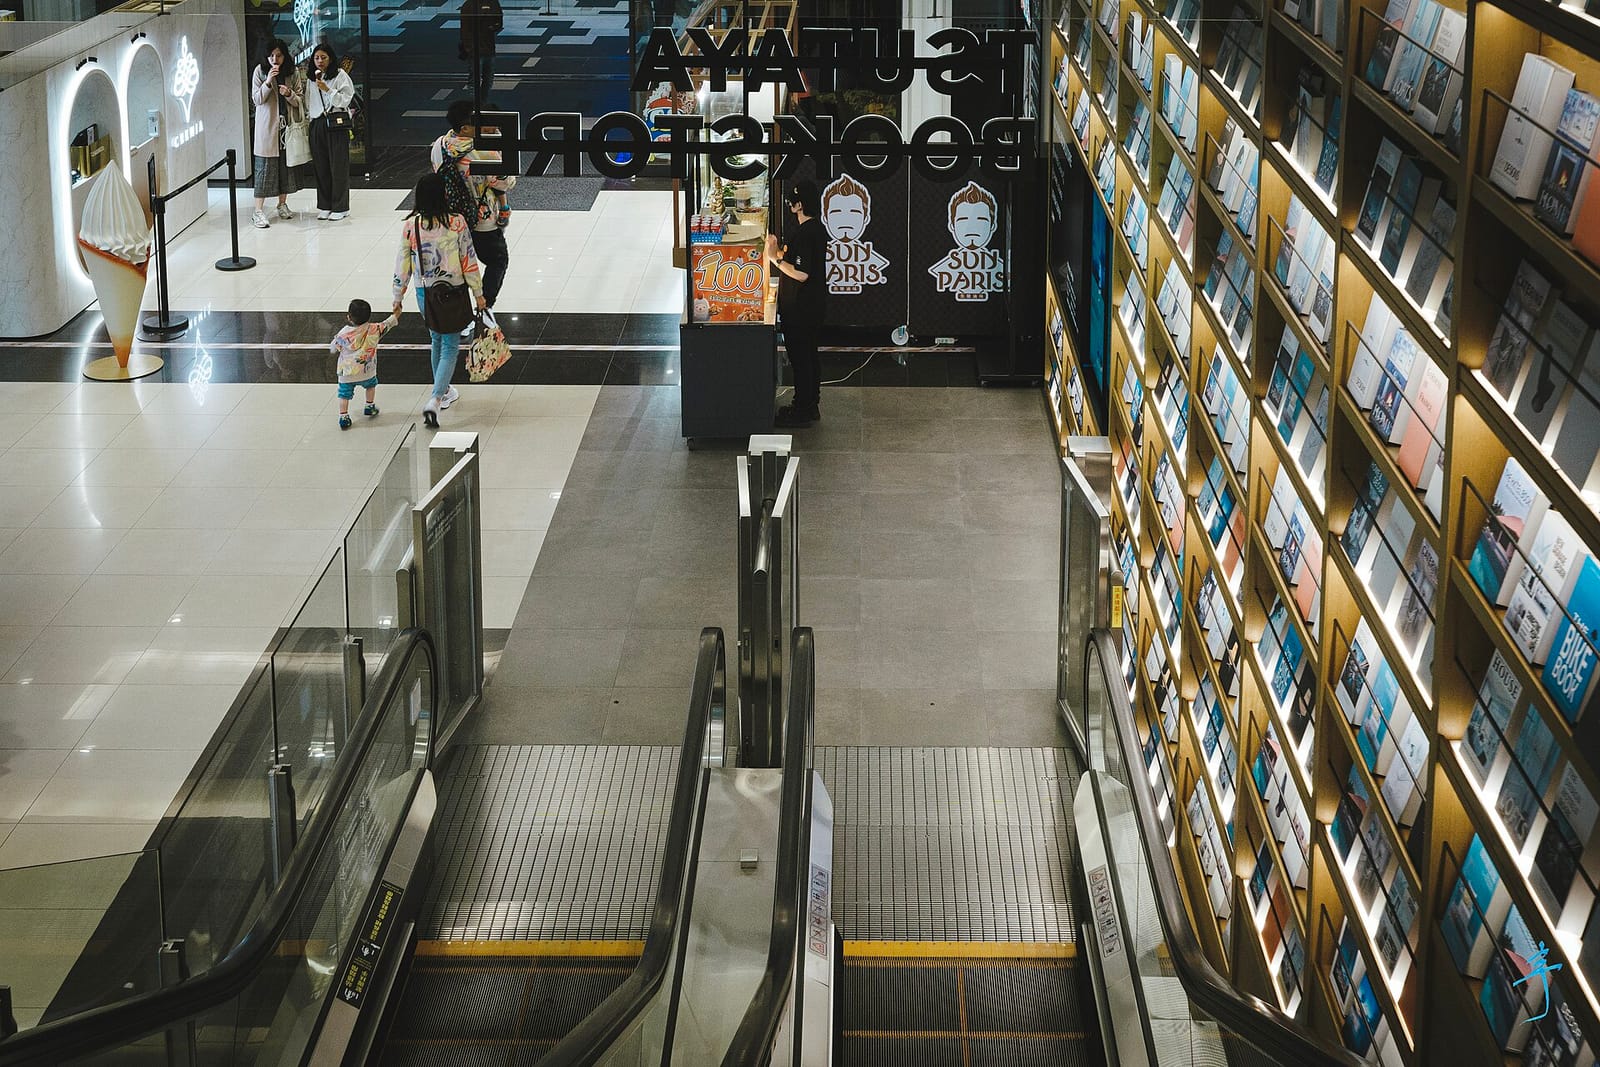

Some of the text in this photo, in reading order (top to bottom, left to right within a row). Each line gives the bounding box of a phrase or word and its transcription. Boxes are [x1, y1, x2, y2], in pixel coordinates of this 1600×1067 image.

[825, 242, 872, 263] SUN
[948, 250, 1000, 270] SUN
[694, 249, 765, 294] 100
[825, 263, 882, 284] ARIS
[937, 271, 1004, 291] PARIS
[1572, 611, 1590, 635] THE
[1559, 623, 1593, 684] BIKE
[1492, 655, 1518, 700] HOUSE
[1551, 656, 1580, 704] BOOK
